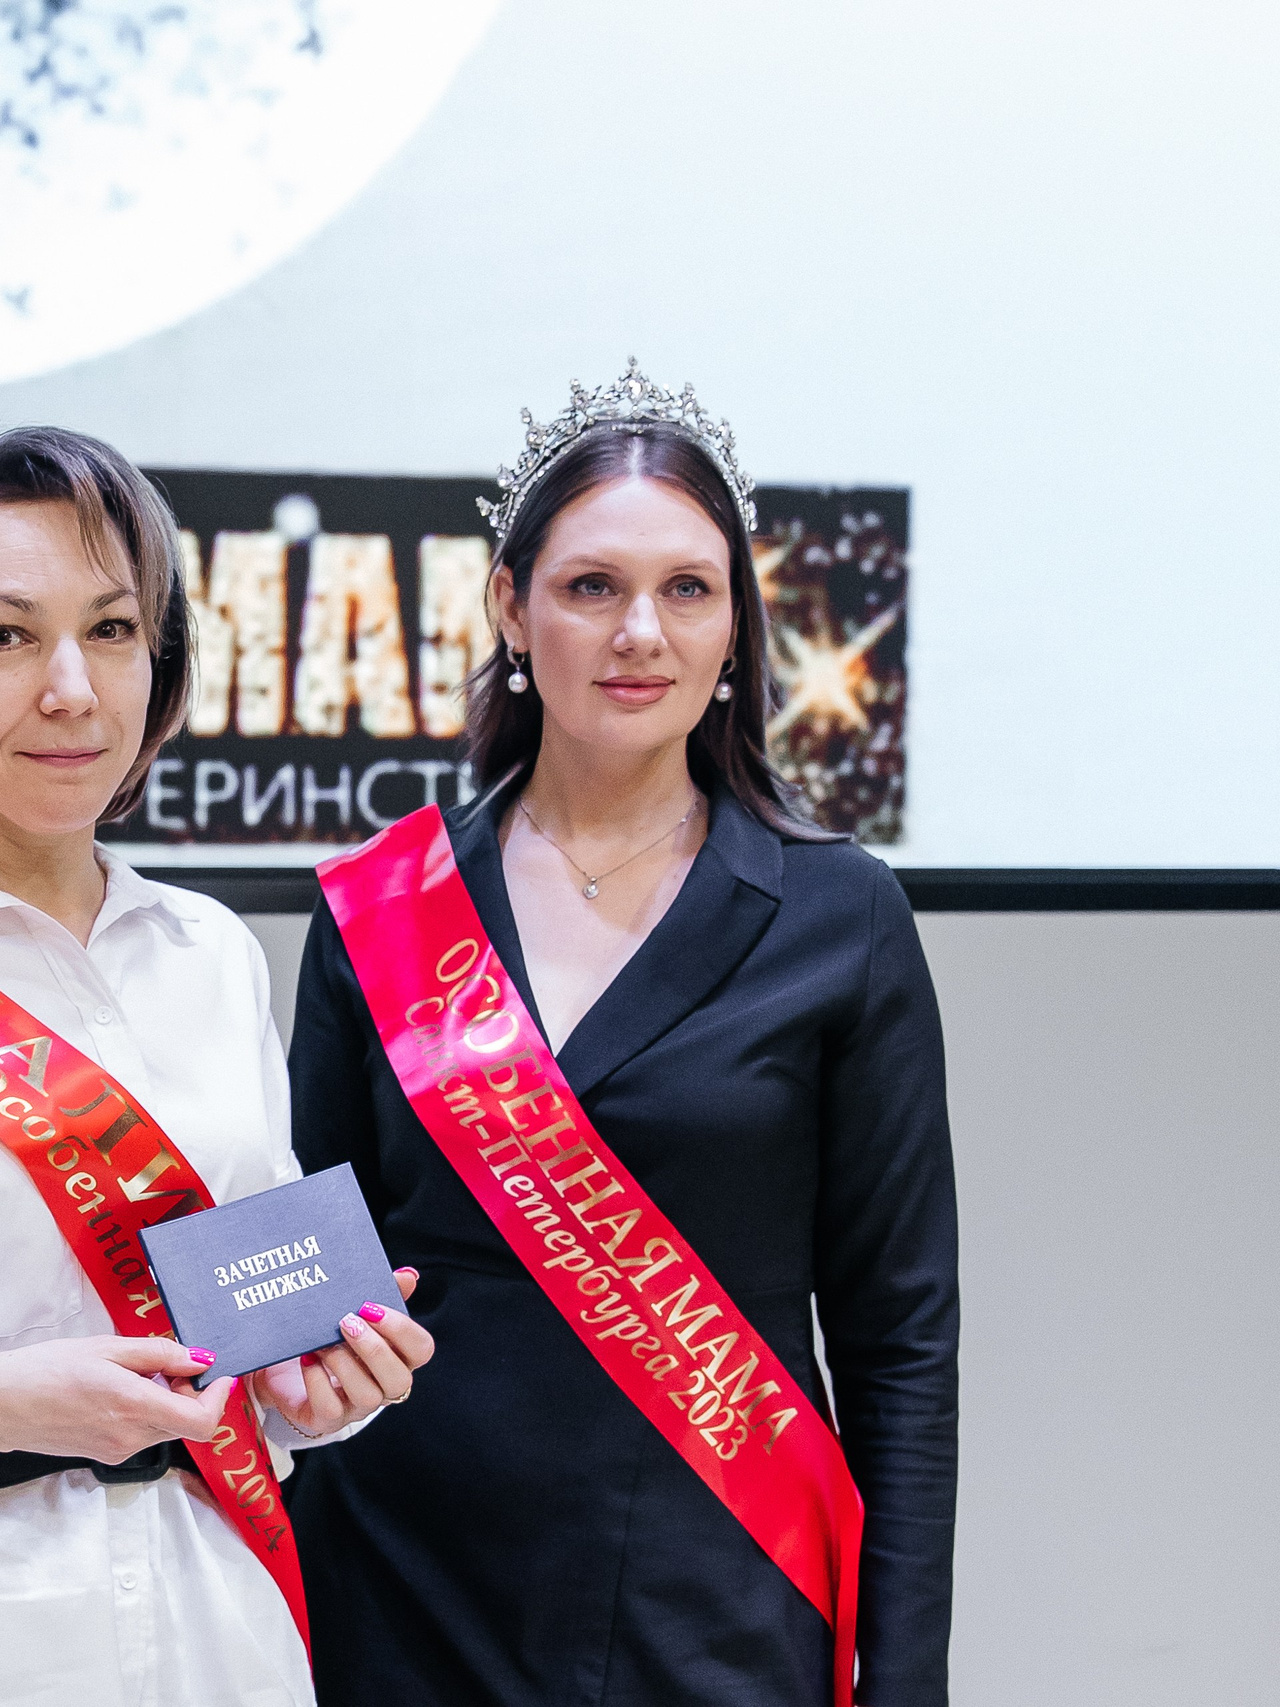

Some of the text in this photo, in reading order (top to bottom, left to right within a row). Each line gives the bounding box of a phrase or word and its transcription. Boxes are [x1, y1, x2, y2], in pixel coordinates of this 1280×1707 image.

[146, 758, 477, 831] ЕРИНСТ
[404, 996, 749, 1462] Санкт-Петербурга 2023
[435, 937, 799, 1456] ОСОБЕННАЯ МАМА
[213, 1235, 322, 1287] ЗАЧЕТНАЯ
[231, 1263, 330, 1311] КНИЖКА
[223, 1449, 287, 1556] 2024
